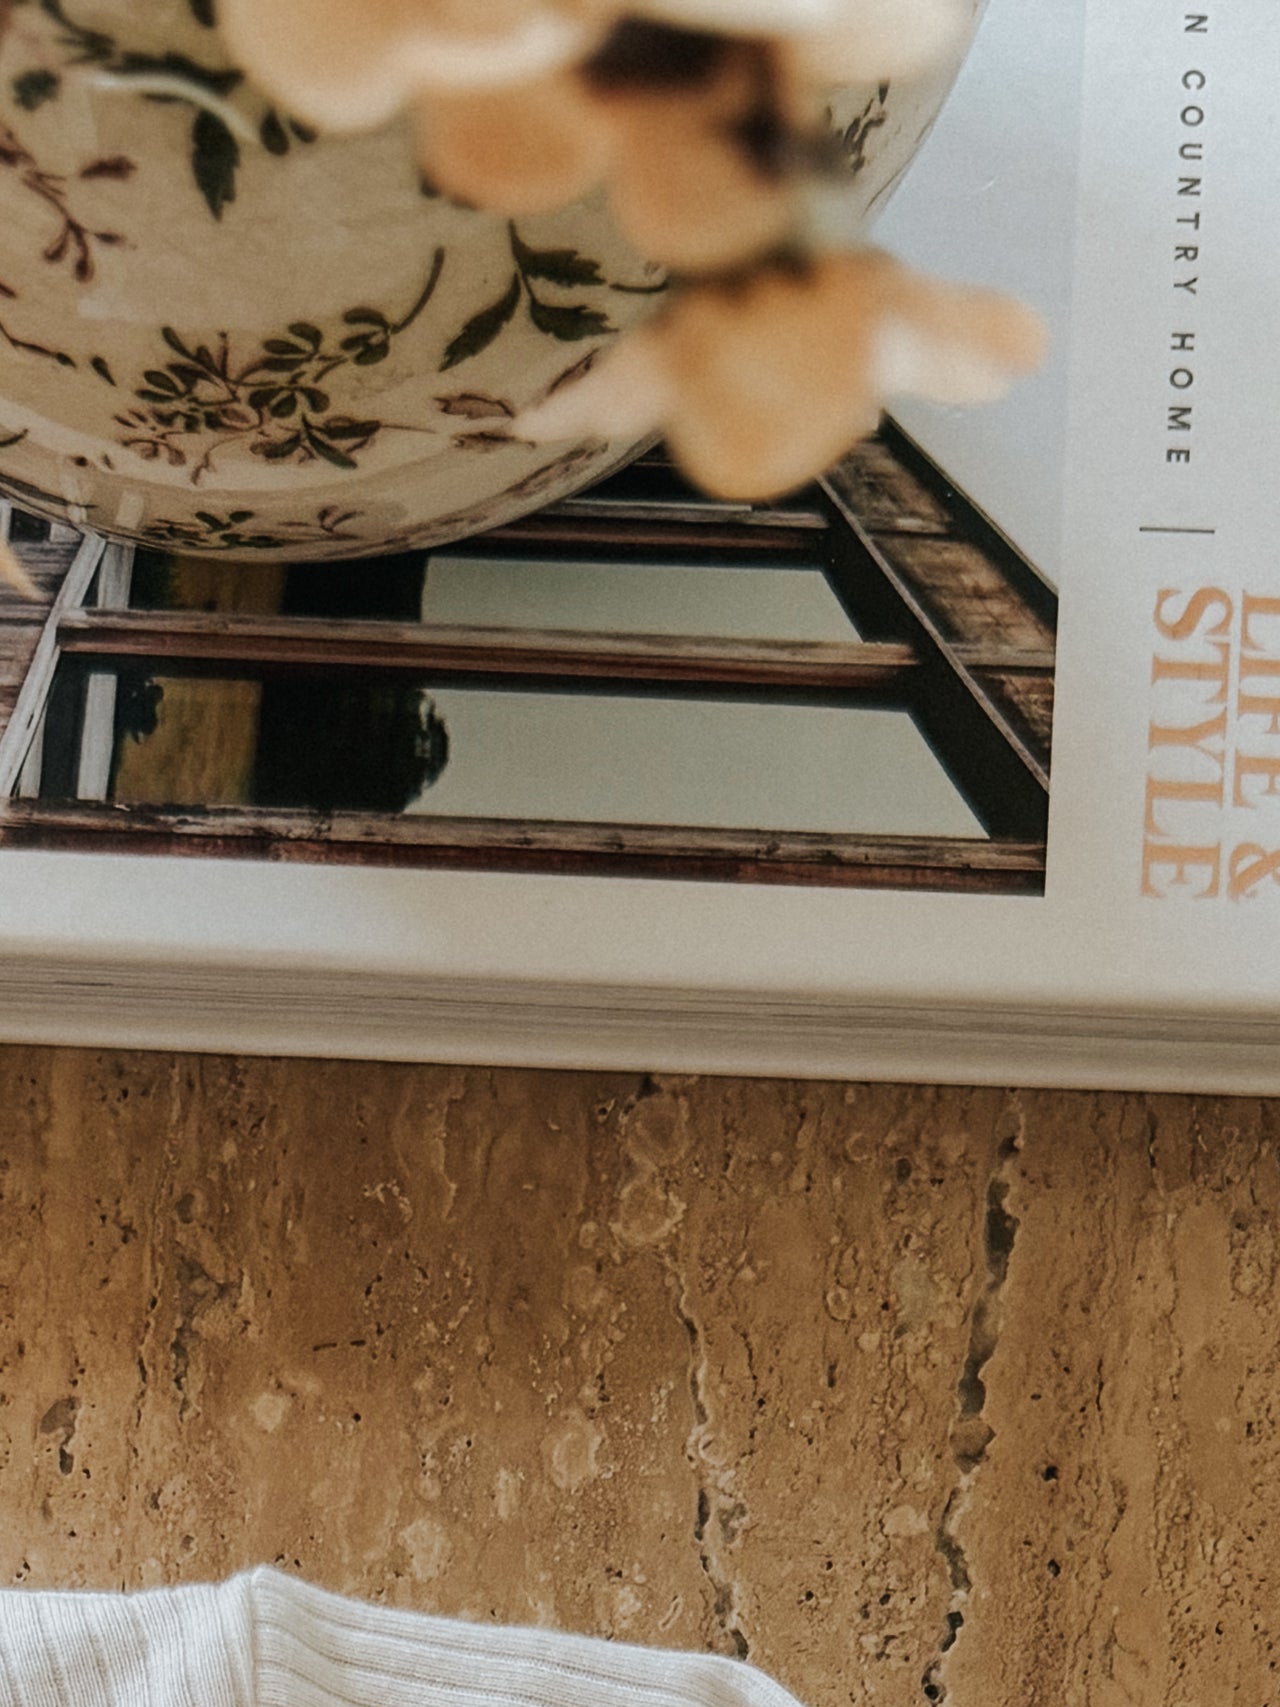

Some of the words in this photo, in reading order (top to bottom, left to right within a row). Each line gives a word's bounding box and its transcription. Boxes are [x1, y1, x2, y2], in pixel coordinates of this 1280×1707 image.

[1172, 68, 1206, 296] COUNTRY
[1165, 331, 1195, 464] HOME
[1138, 585, 1233, 899] STYLE
